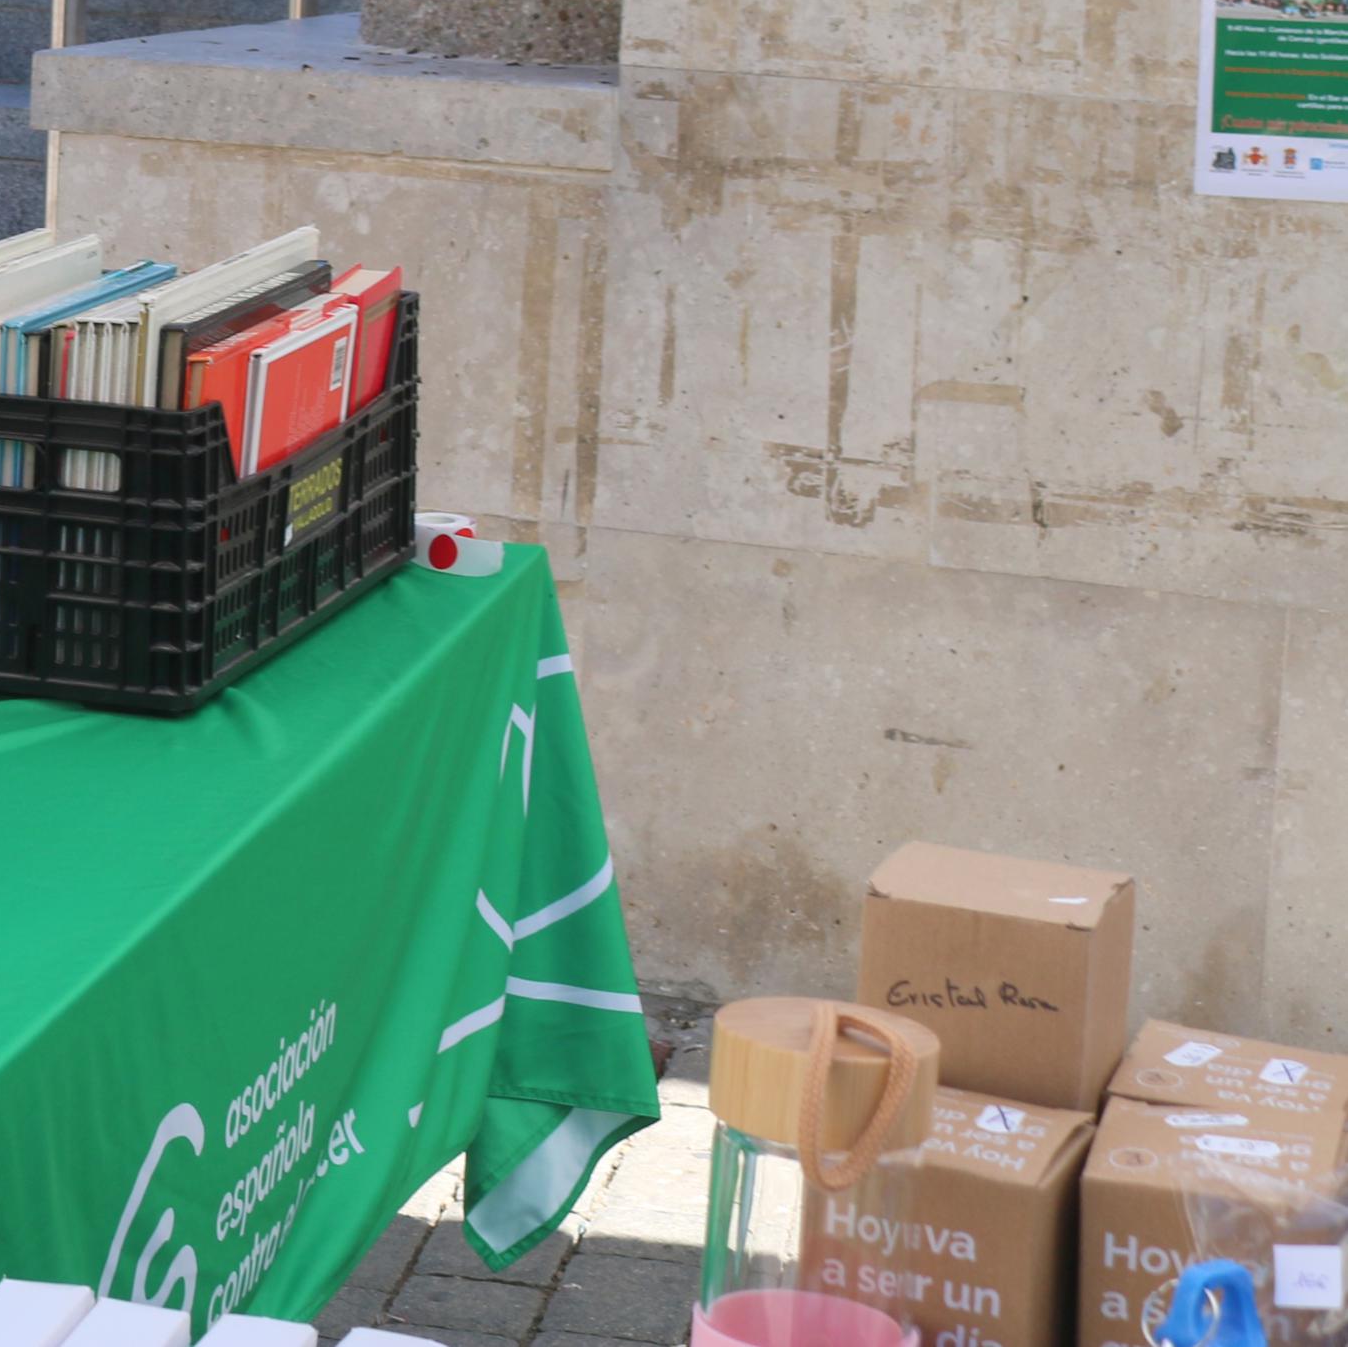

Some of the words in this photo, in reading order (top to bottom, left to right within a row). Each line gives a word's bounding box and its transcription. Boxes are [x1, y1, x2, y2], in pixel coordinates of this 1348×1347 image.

[224, 998, 337, 1149] asociación
[215, 1099, 316, 1242] española
[823, 1197, 901, 1257] Hoy
[923, 1224, 977, 1263] va
[821, 1258, 847, 1288] a
[857, 1264, 933, 1301] ser
[943, 1279, 1001, 1318] un
